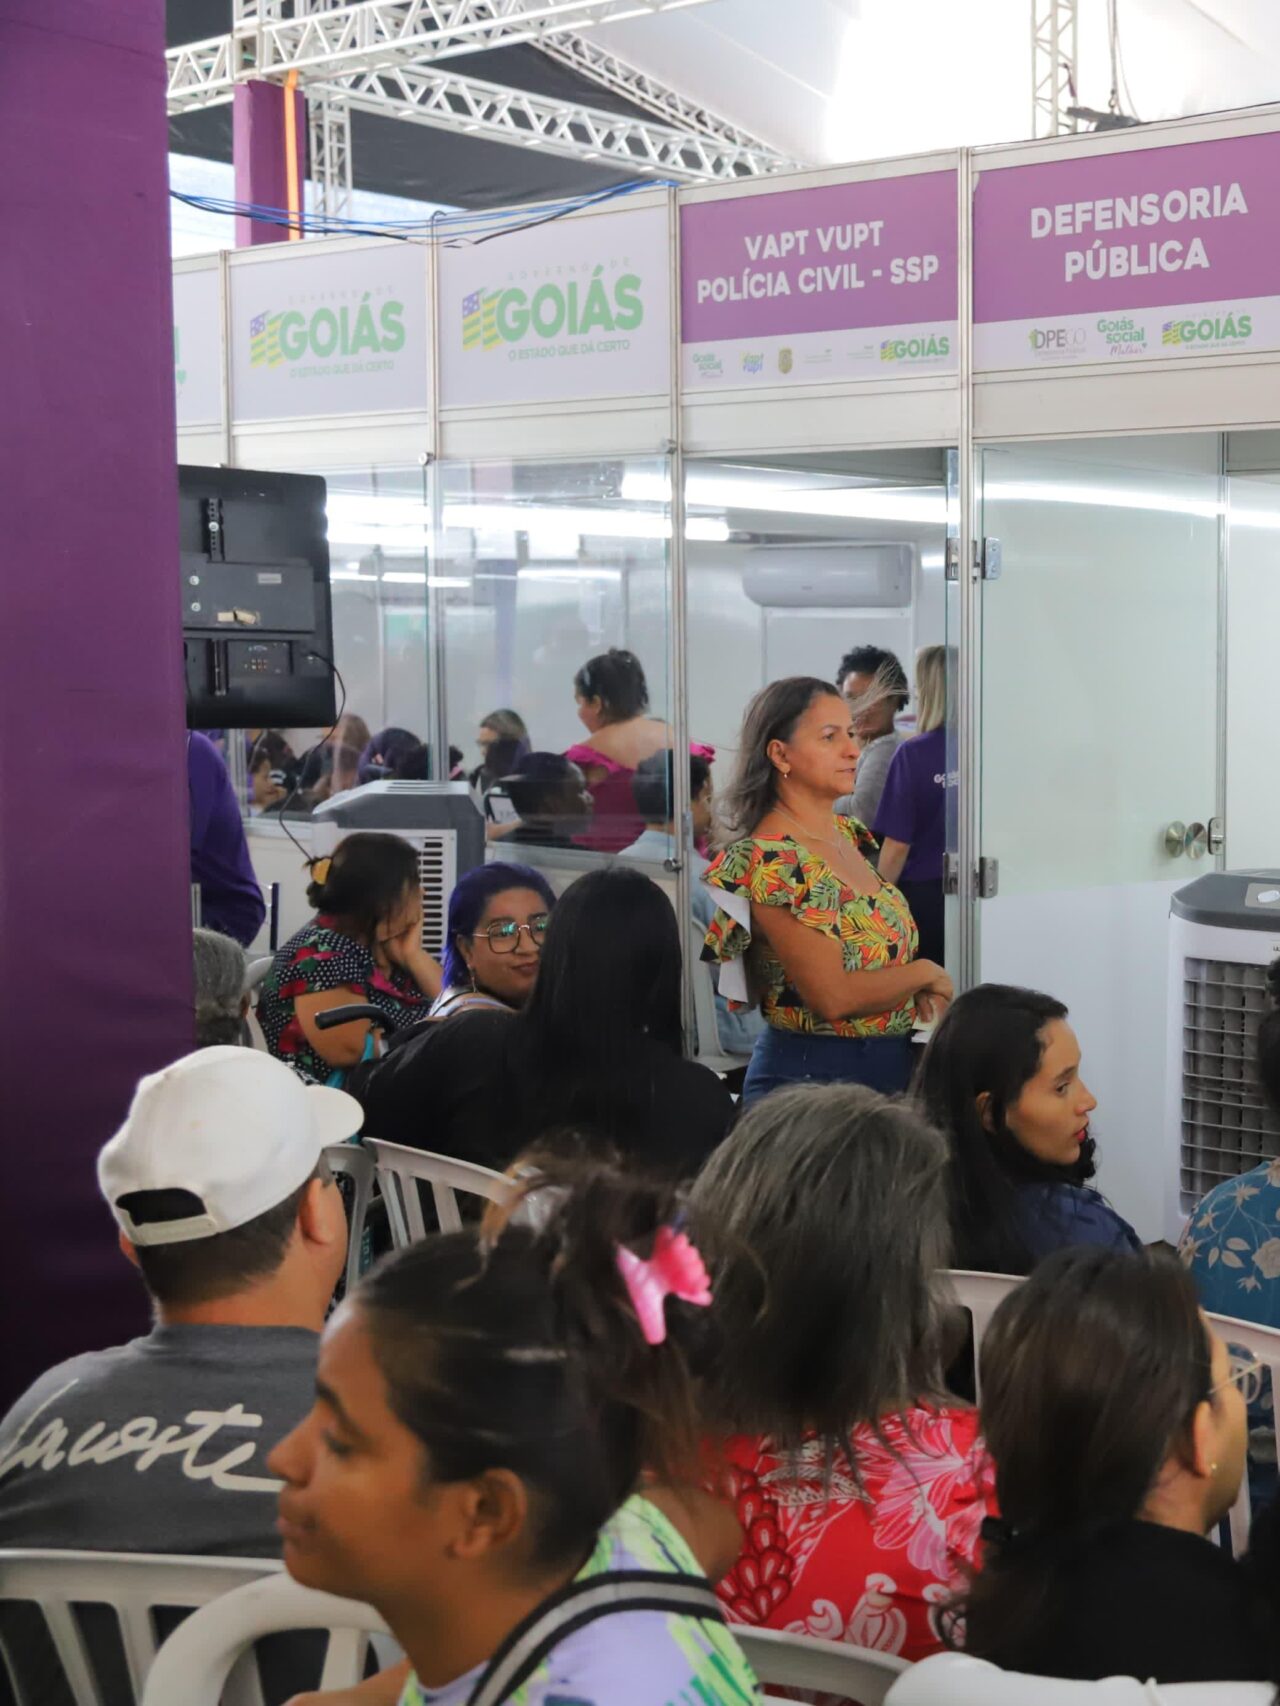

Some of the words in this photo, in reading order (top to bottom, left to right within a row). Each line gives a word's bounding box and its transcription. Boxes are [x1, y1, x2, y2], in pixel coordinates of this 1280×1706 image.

[1031, 182, 1249, 239] DEFENSORIA
[744, 229, 809, 261] VAPT
[817, 220, 885, 252] VUPT
[1064, 237, 1210, 283] PÚBLICA
[697, 267, 791, 304] POLÍCIA
[798, 263, 865, 295] CIVIL
[890, 255, 939, 285] SSP
[279, 290, 406, 361] GOIÁS
[496, 264, 644, 343] GOIÁS
[1179, 311, 1253, 342] GOIÁS
[893, 333, 950, 358] GOIÁS
